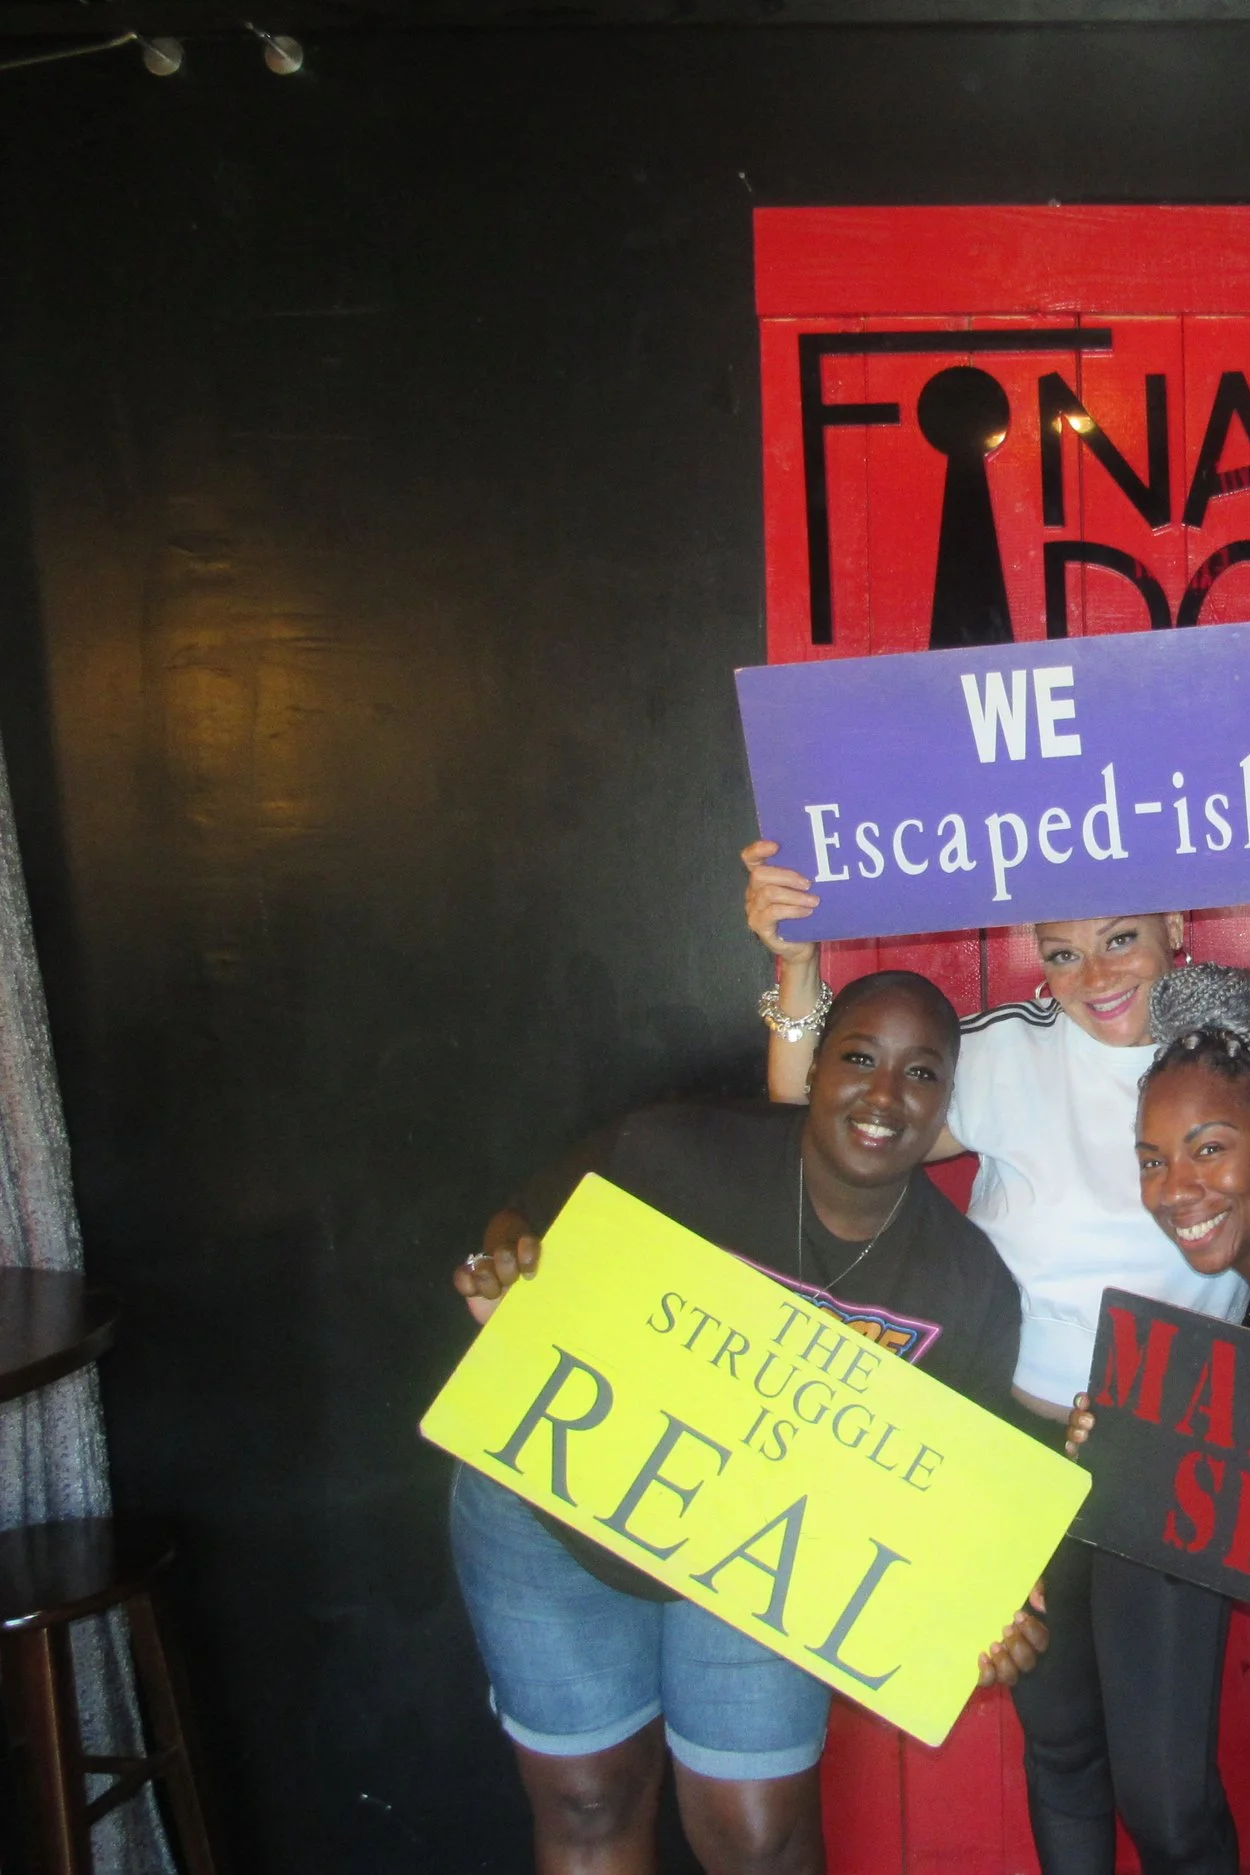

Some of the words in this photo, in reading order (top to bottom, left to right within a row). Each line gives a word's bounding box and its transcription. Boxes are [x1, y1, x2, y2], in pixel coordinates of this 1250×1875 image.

[960, 666, 1082, 763] WE
[646, 1291, 945, 1491] STRUGGLE
[772, 1301, 882, 1394] THE
[740, 1406, 799, 1461] IS
[484, 1343, 912, 1691] REAL
